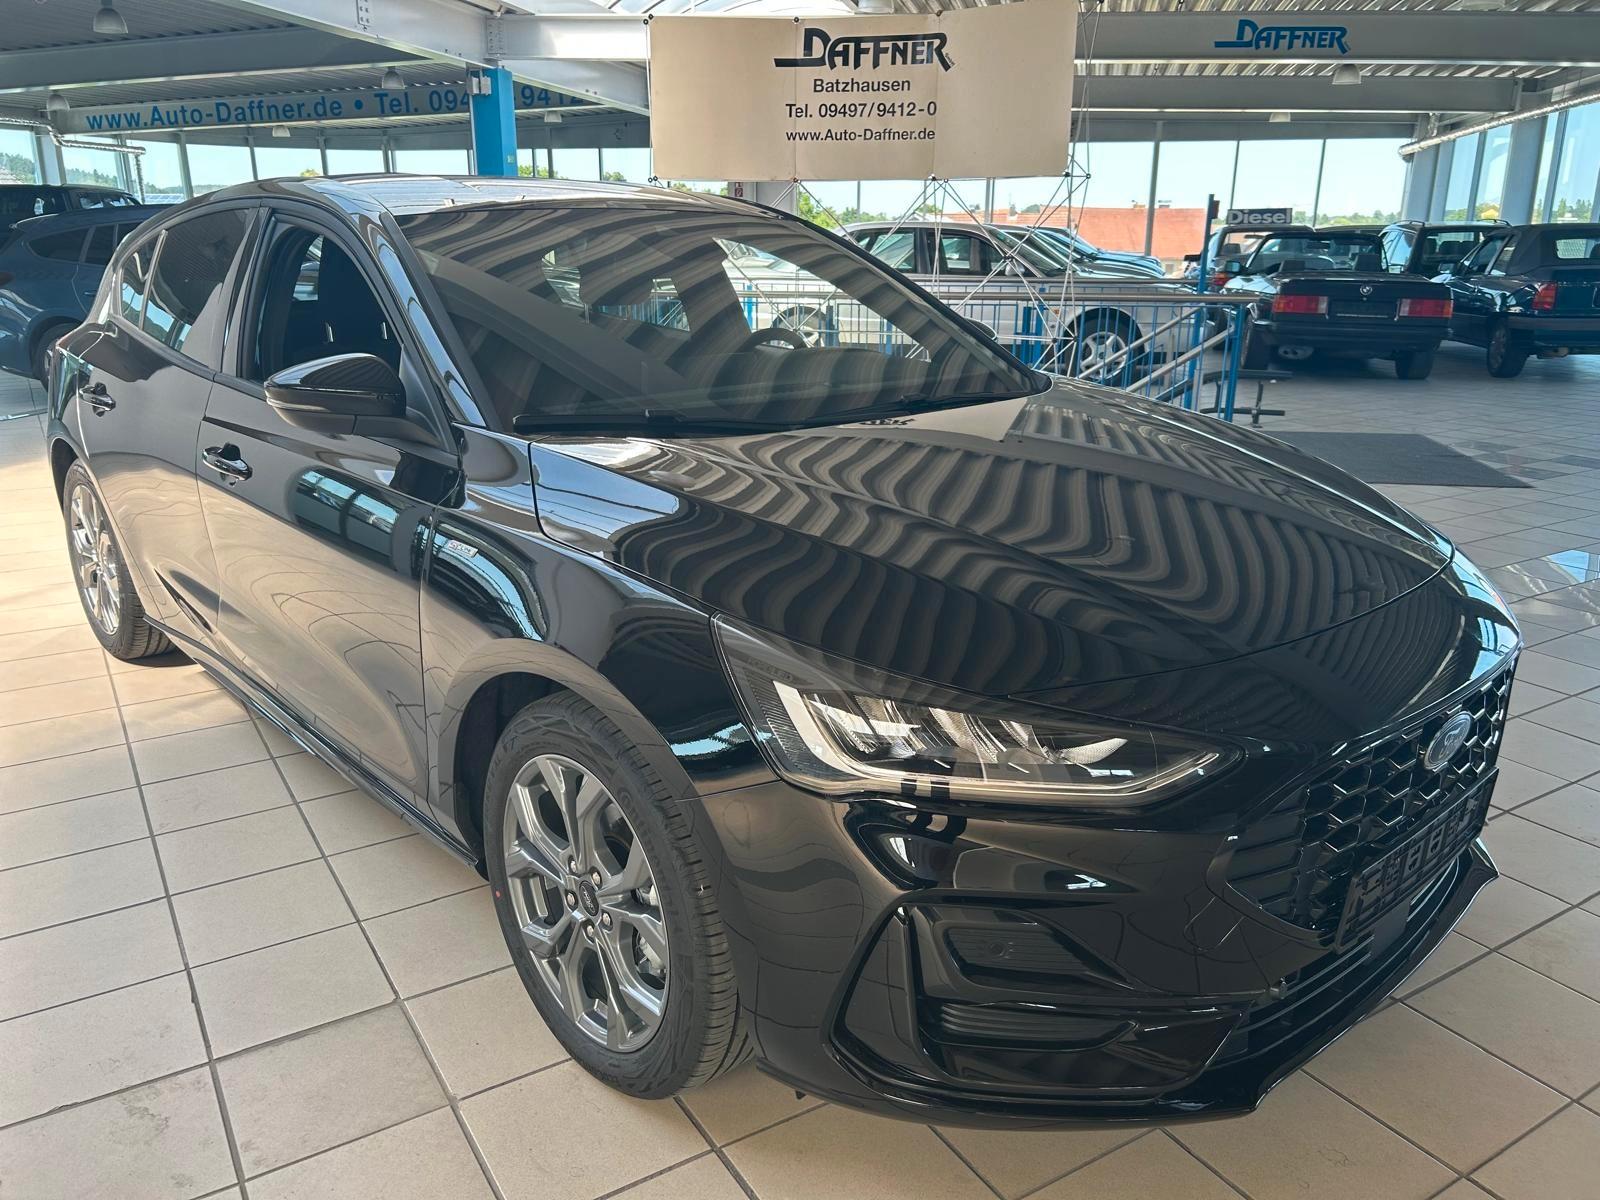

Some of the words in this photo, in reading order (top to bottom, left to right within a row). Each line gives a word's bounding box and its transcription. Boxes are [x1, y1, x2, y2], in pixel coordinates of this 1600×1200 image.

[1214, 19, 1348, 54] DAFFNER
[774, 28, 952, 72] DAFFNER
[813, 78, 911, 93] Batzhausen
[86, 96, 343, 130] www.Auto-Daffner.de
[374, 92, 419, 115] Tel.
[785, 103, 813, 118] Tel.
[786, 128, 936, 141] www.Auto-Daffner.de
[1227, 208, 1292, 224] Diesel
